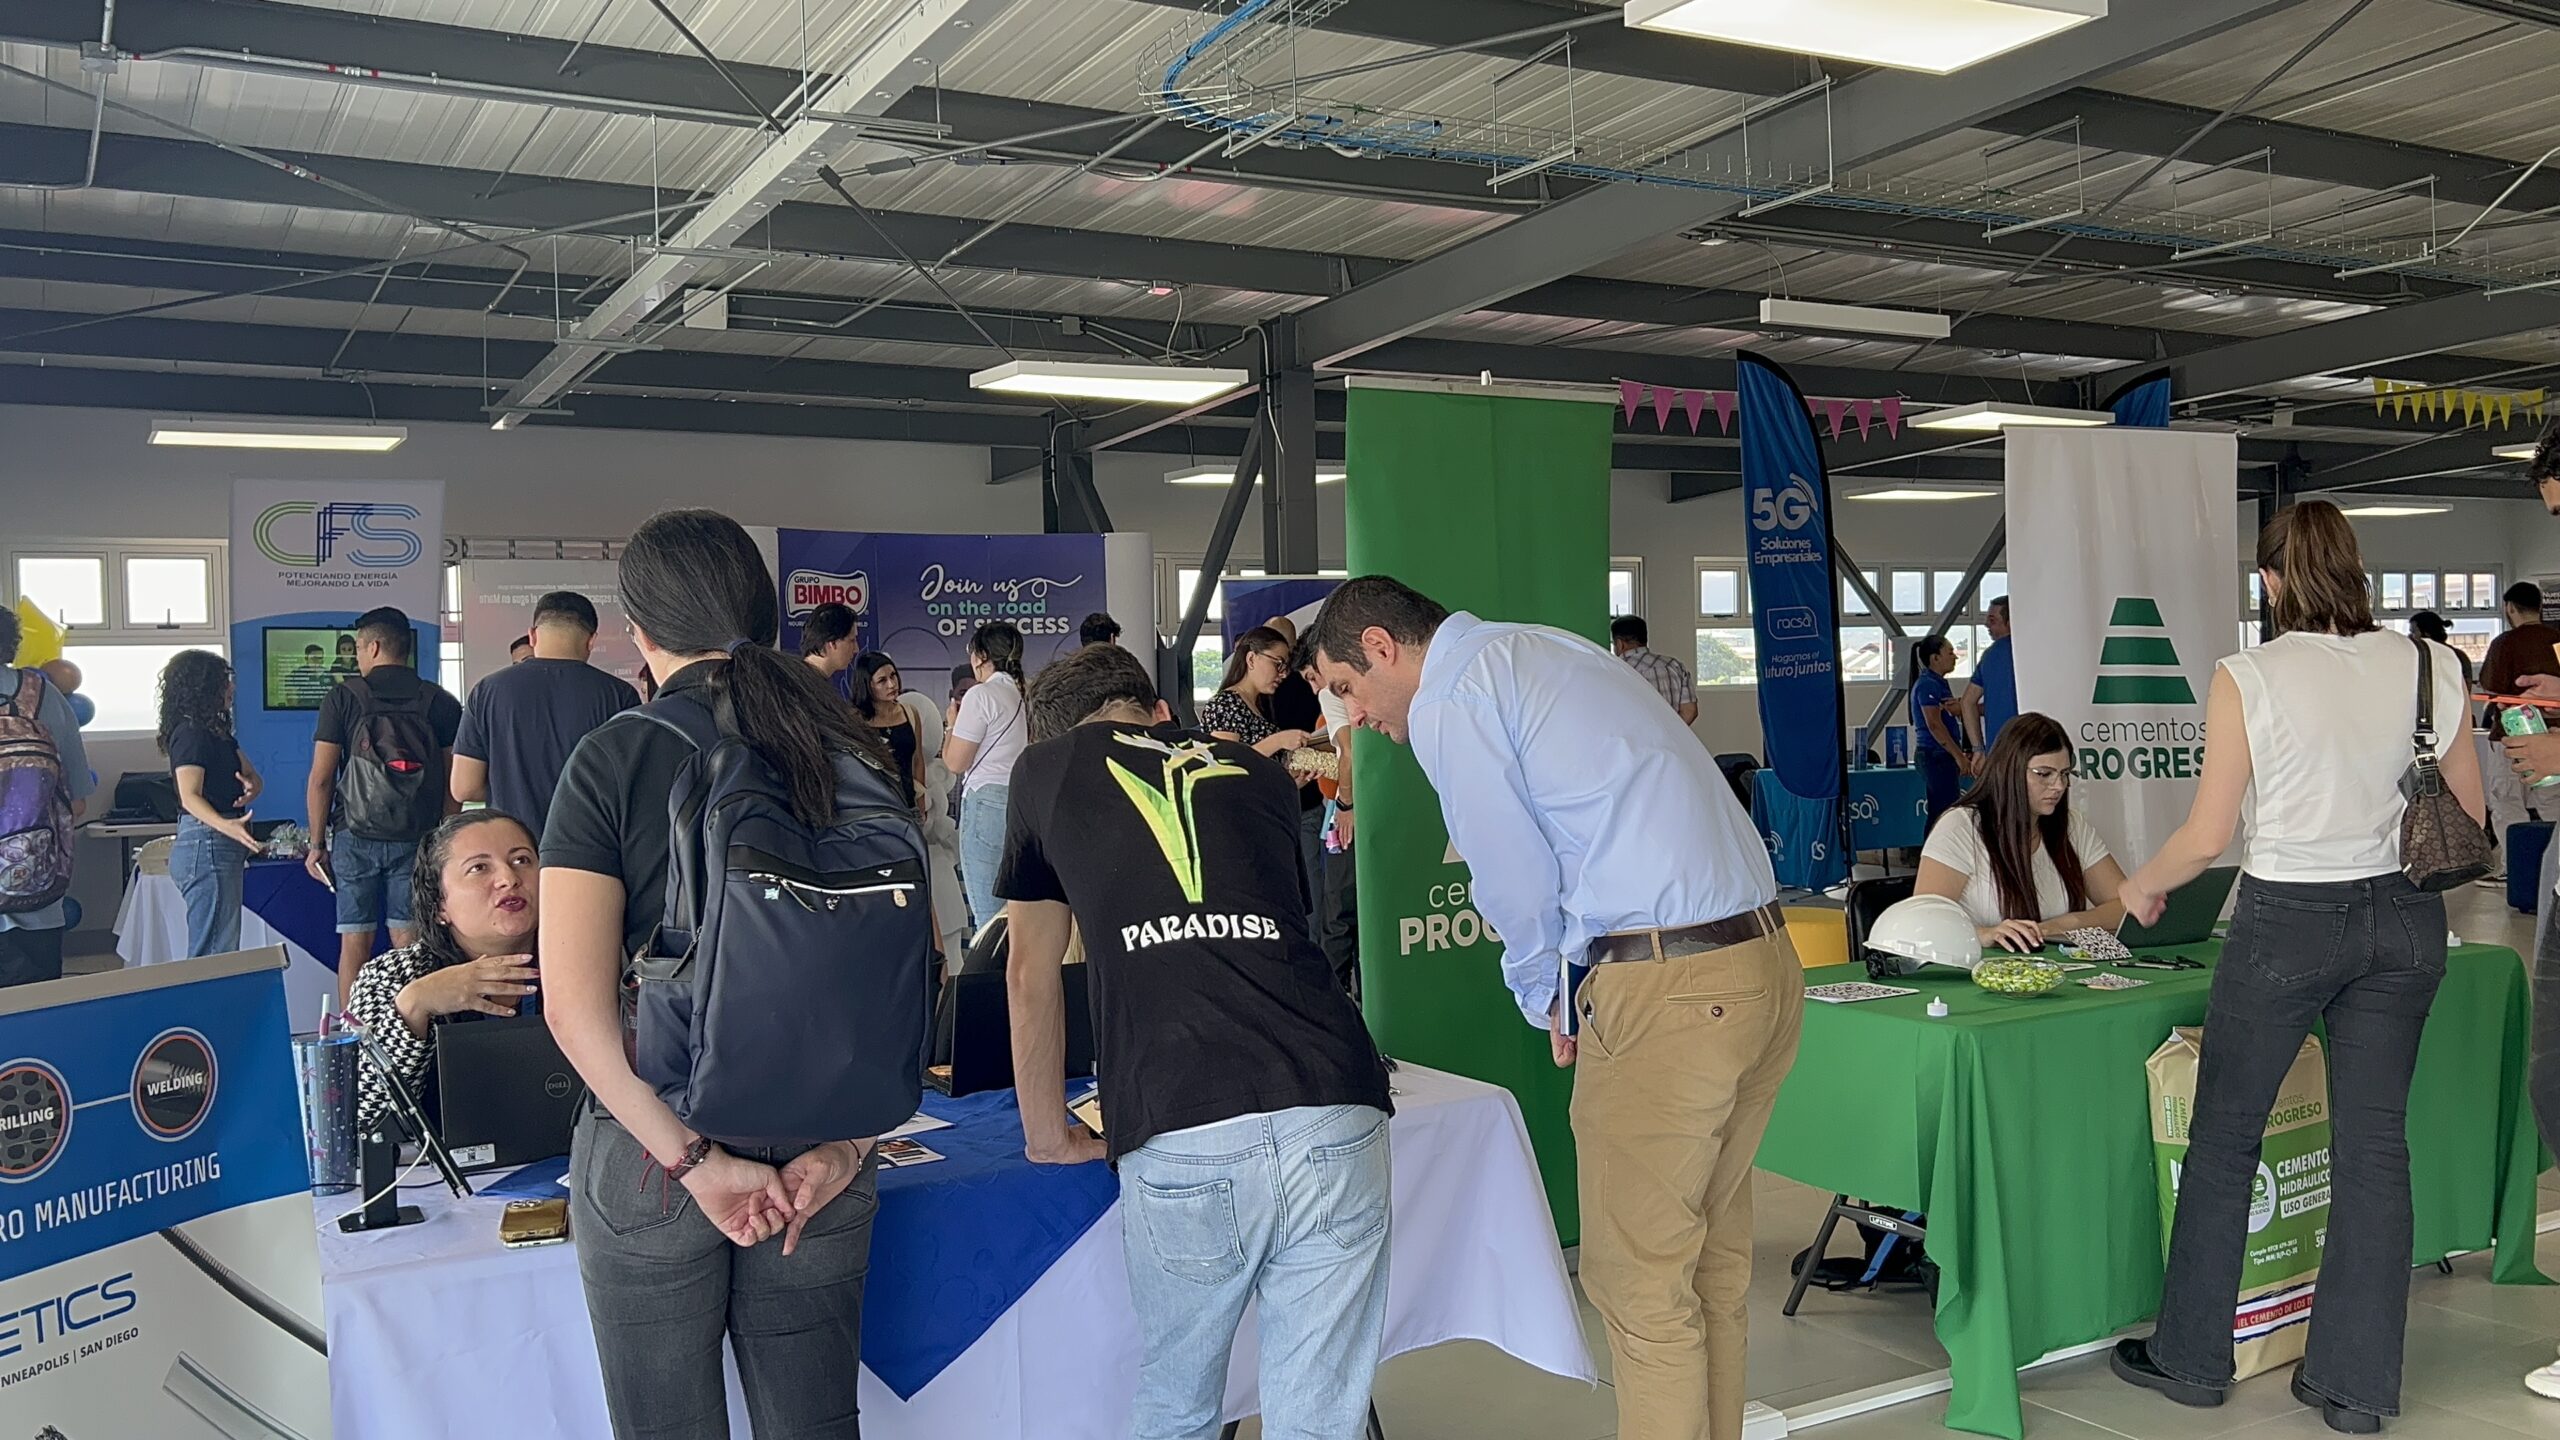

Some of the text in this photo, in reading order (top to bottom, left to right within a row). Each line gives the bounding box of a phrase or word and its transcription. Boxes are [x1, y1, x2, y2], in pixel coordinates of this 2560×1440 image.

[1752, 487, 1811, 531] 5G
[253, 501, 422, 567] CFS
[278, 571, 398, 580] POTENCIANDO ENERGÍA
[286, 580, 390, 588] MEJORANDO LA VIDA
[794, 576, 820, 584] GRUPO
[920, 564, 983, 601] Join
[794, 584, 862, 605] BIMBO
[927, 599, 1046, 616] on the road
[937, 618, 967, 636] OF
[1777, 616, 1811, 629] racsa
[1771, 652, 1811, 664] Hagamos
[1121, 913, 1280, 952] PARADISE
[147, 1072, 203, 1096] WELDING
[2277, 1094, 2305, 1108] entos
[0, 1106, 54, 1132] RILLING
[2267, 1101, 2322, 1128] ROGRESO
[2277, 1148, 2330, 1178] CEMENTO
[35, 1152, 221, 1232] MANUFACTURING
[2283, 1189, 2330, 1214] USO GENERA
[0, 1272, 137, 1358] ETICS
[2250, 1307, 2283, 1324] CEMENTO
[2284, 1304, 2293, 1313] DE
[2293, 1299, 2306, 1311] LOS
[1, 1327, 139, 1388] NNEAPOLIS SAN DIEGO
